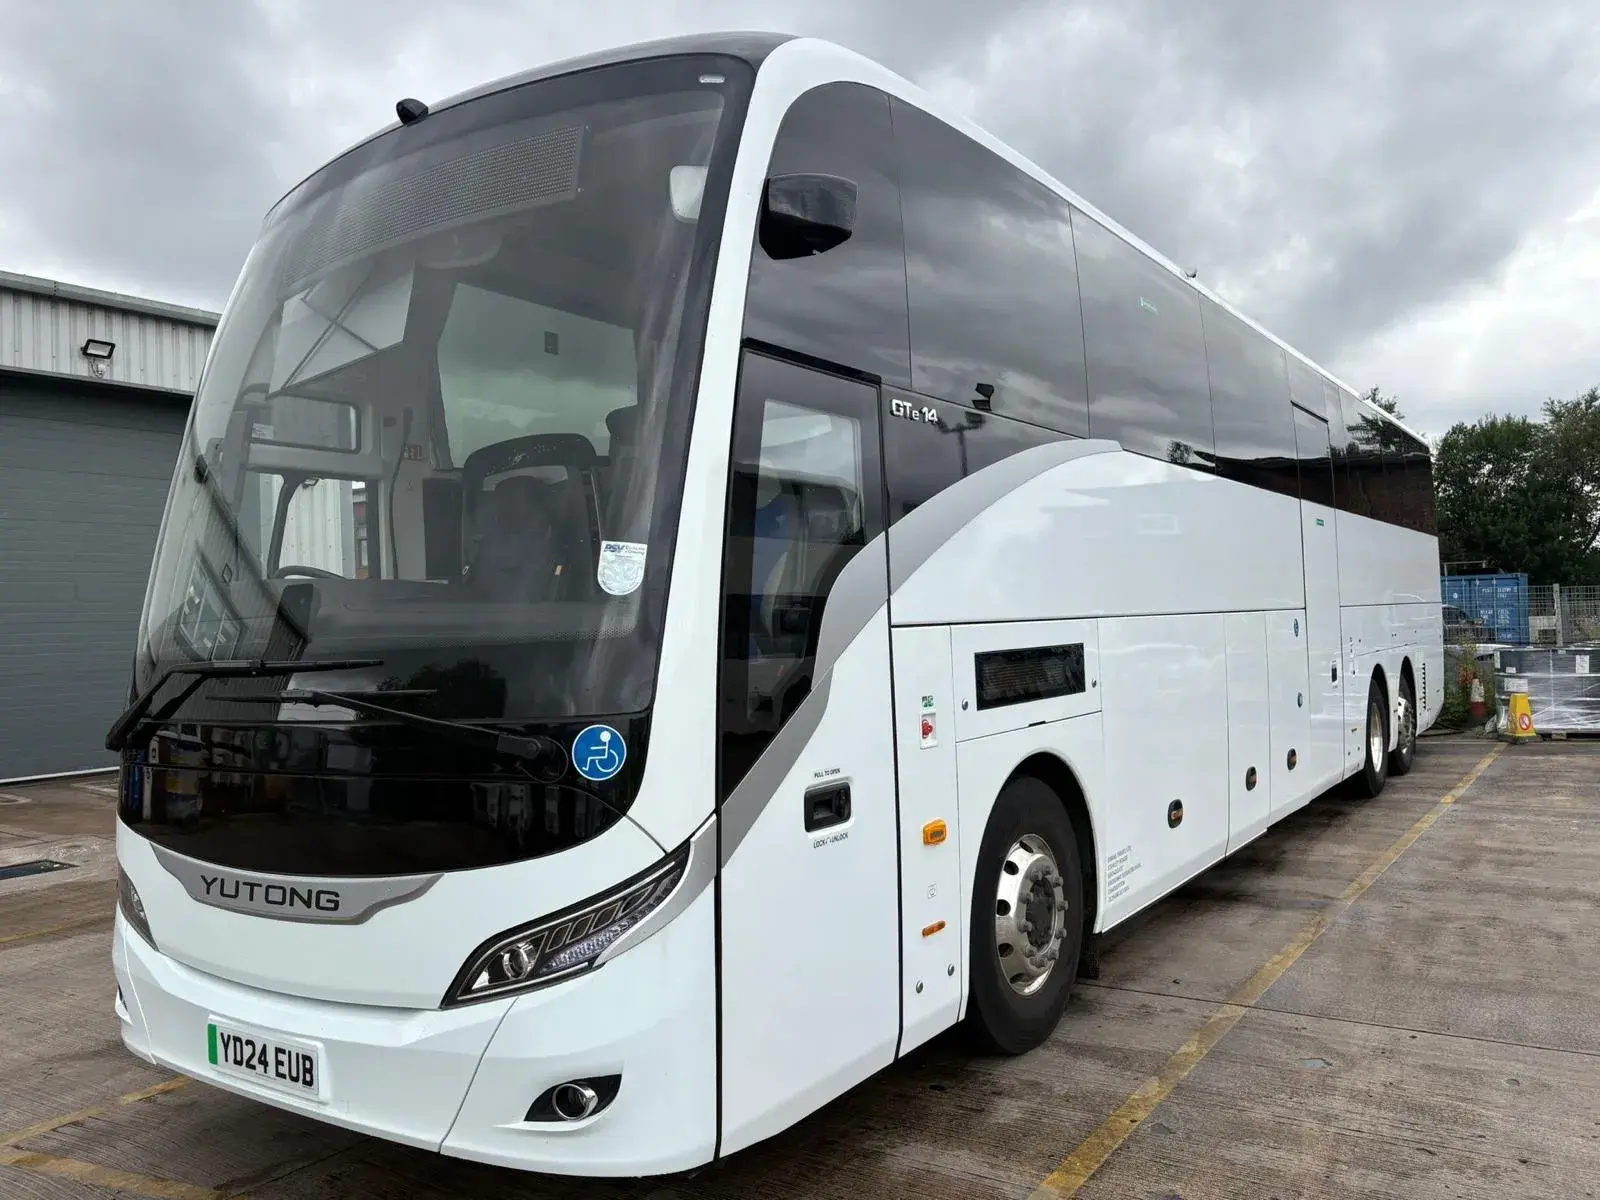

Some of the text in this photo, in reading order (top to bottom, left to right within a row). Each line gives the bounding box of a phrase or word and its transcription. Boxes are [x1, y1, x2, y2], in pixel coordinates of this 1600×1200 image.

[922, 407, 938, 422] 14
[200, 874, 340, 911] YUTONG
[220, 1032, 314, 1087] YD24 EUB
